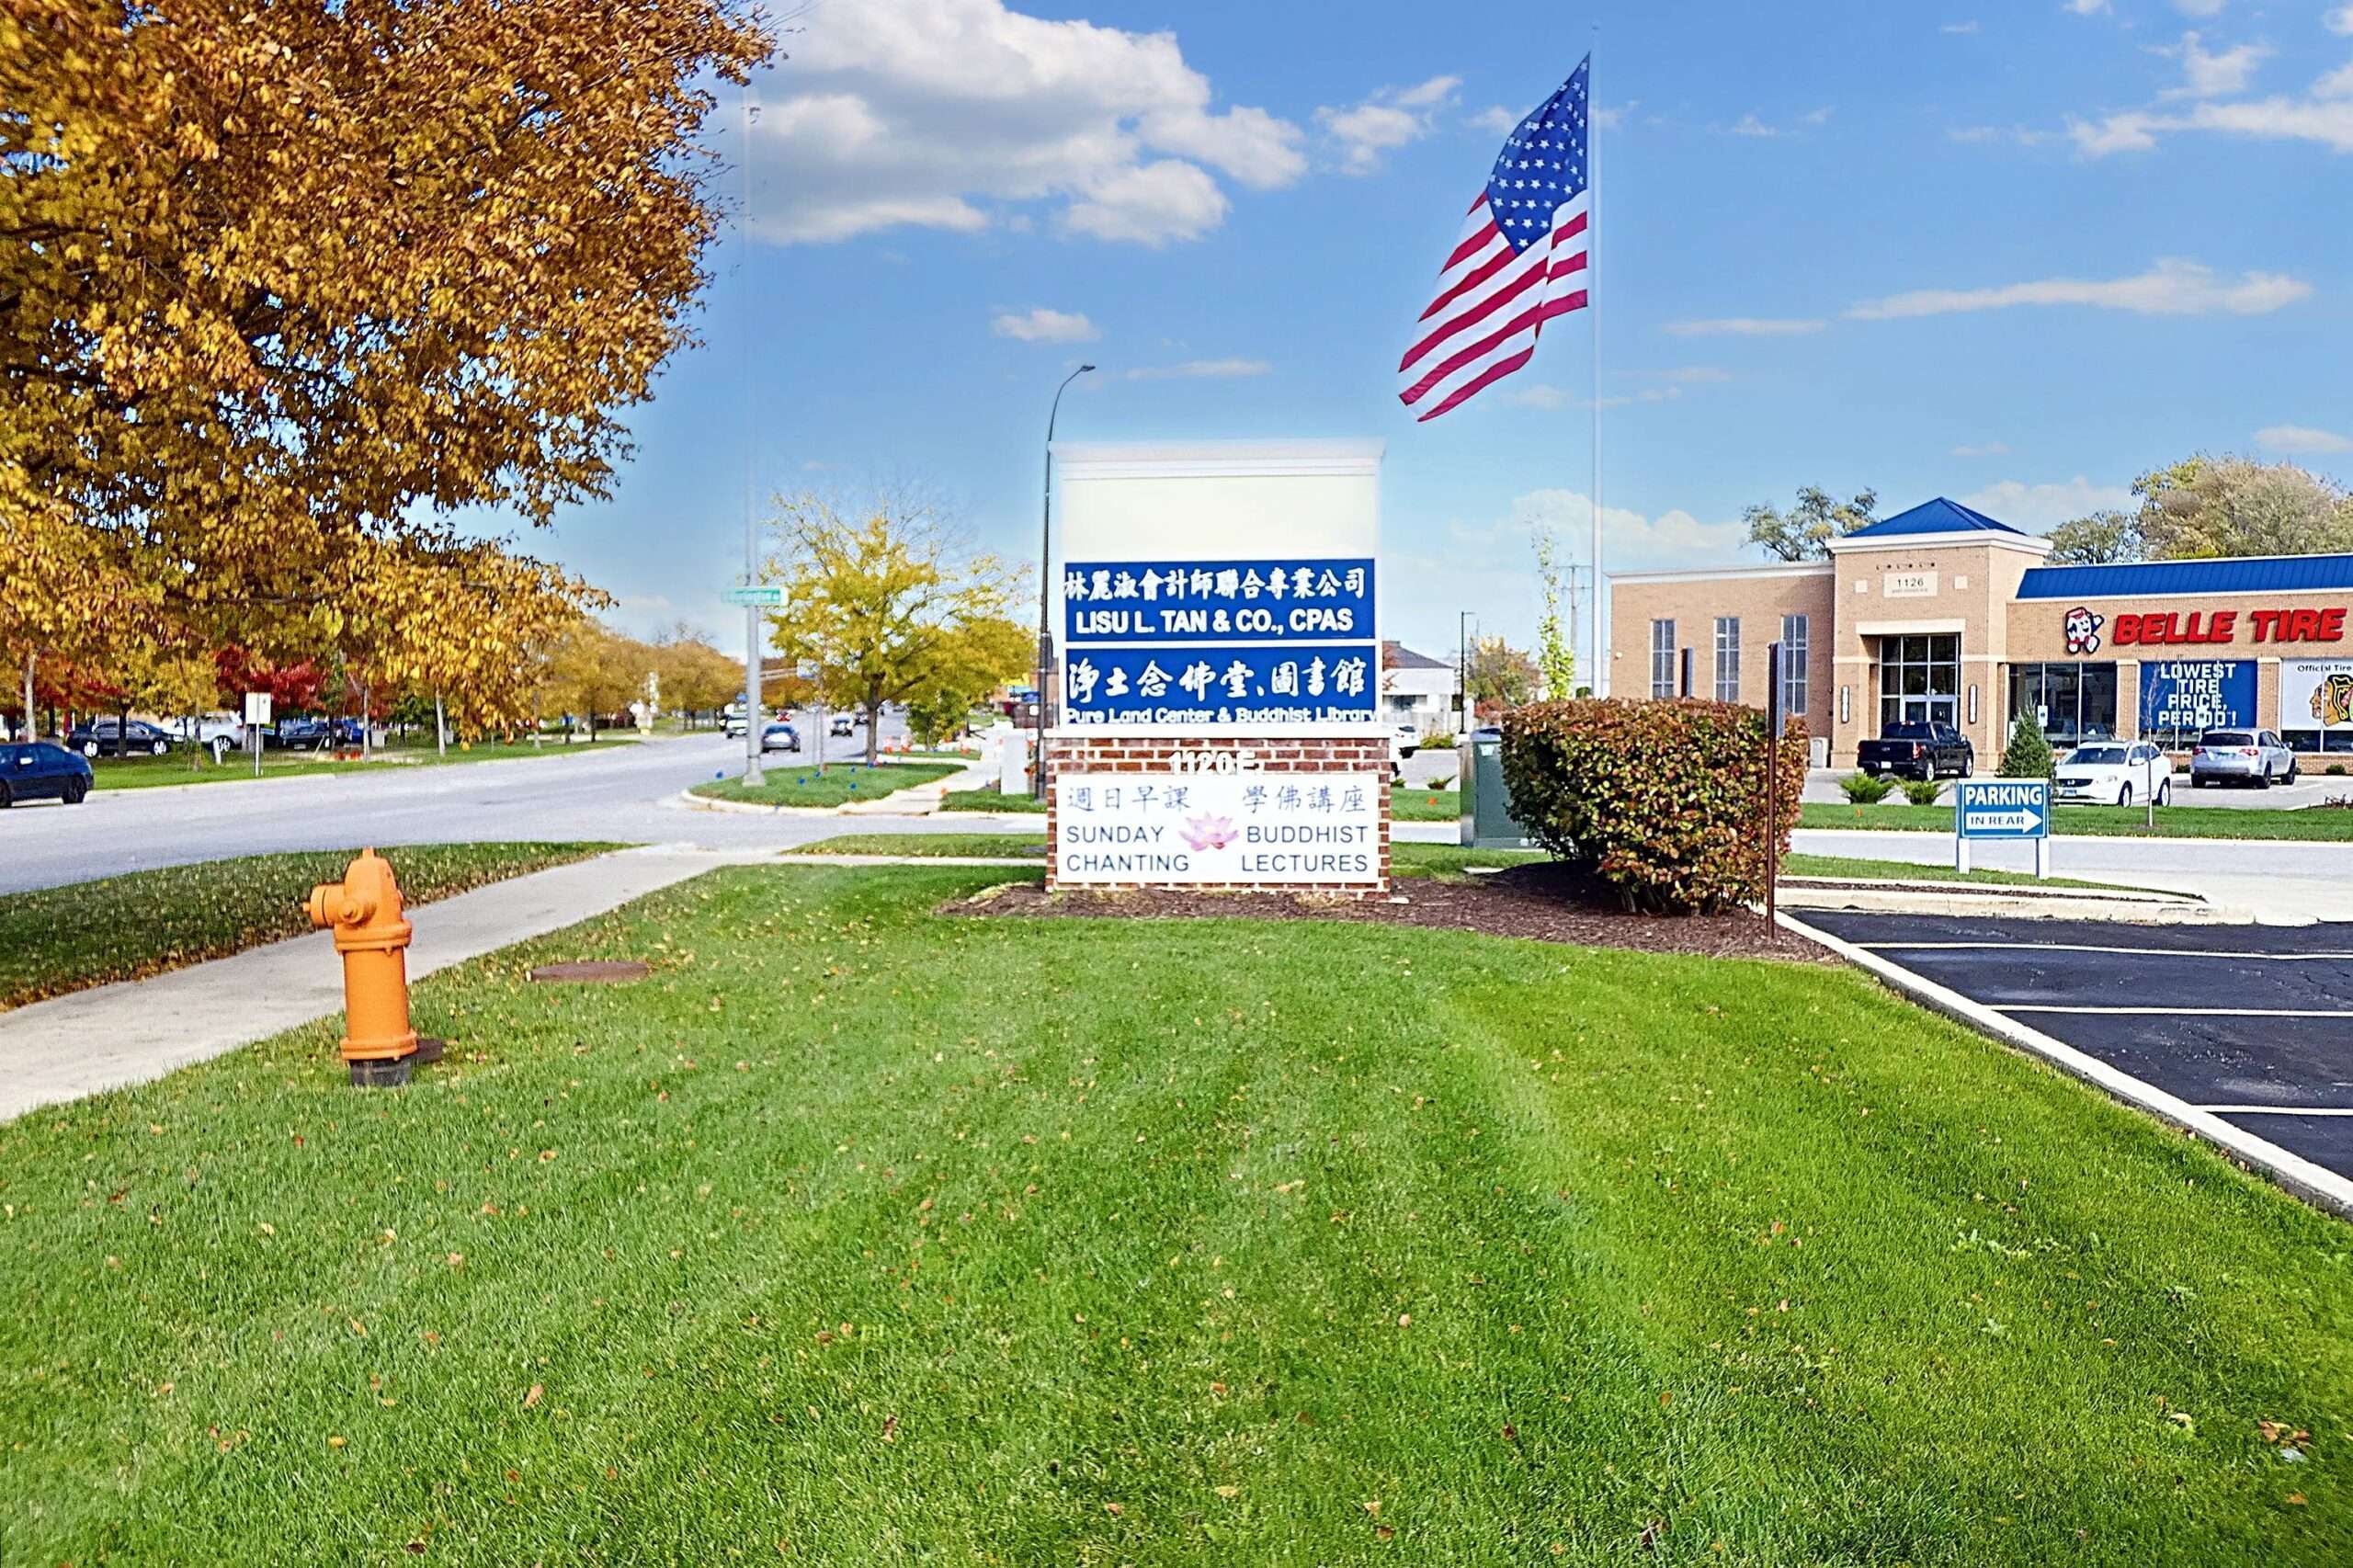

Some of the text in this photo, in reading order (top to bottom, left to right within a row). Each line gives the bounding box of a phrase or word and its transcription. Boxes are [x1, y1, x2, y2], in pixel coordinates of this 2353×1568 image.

[1897, 577, 1925, 587] 1126
[1075, 608, 1354, 636] LISU L. TAN & CO., CPAS
[2113, 608, 2347, 644] BELLE TIRE
[2160, 663, 2237, 679] LOWEST
[2335, 664, 2353, 672] Tire
[2178, 678, 2219, 694] TIRE
[2167, 694, 2228, 710] PRICE,
[1067, 706, 1378, 723] Pure Land Center & Buddhist Library
[2158, 710, 2237, 727] PEROD!
[1067, 785, 1191, 813] 週日早課
[1242, 784, 1366, 814] 學佛講座
[1965, 786, 2043, 806] PARKING
[1971, 815, 2025, 825] IN REAR
[1066, 825, 1165, 844] SUNDAY
[1246, 825, 1369, 844] BUDDHIST
[1066, 854, 1189, 872] CHANTING
[1242, 854, 1369, 872] LECTURES
